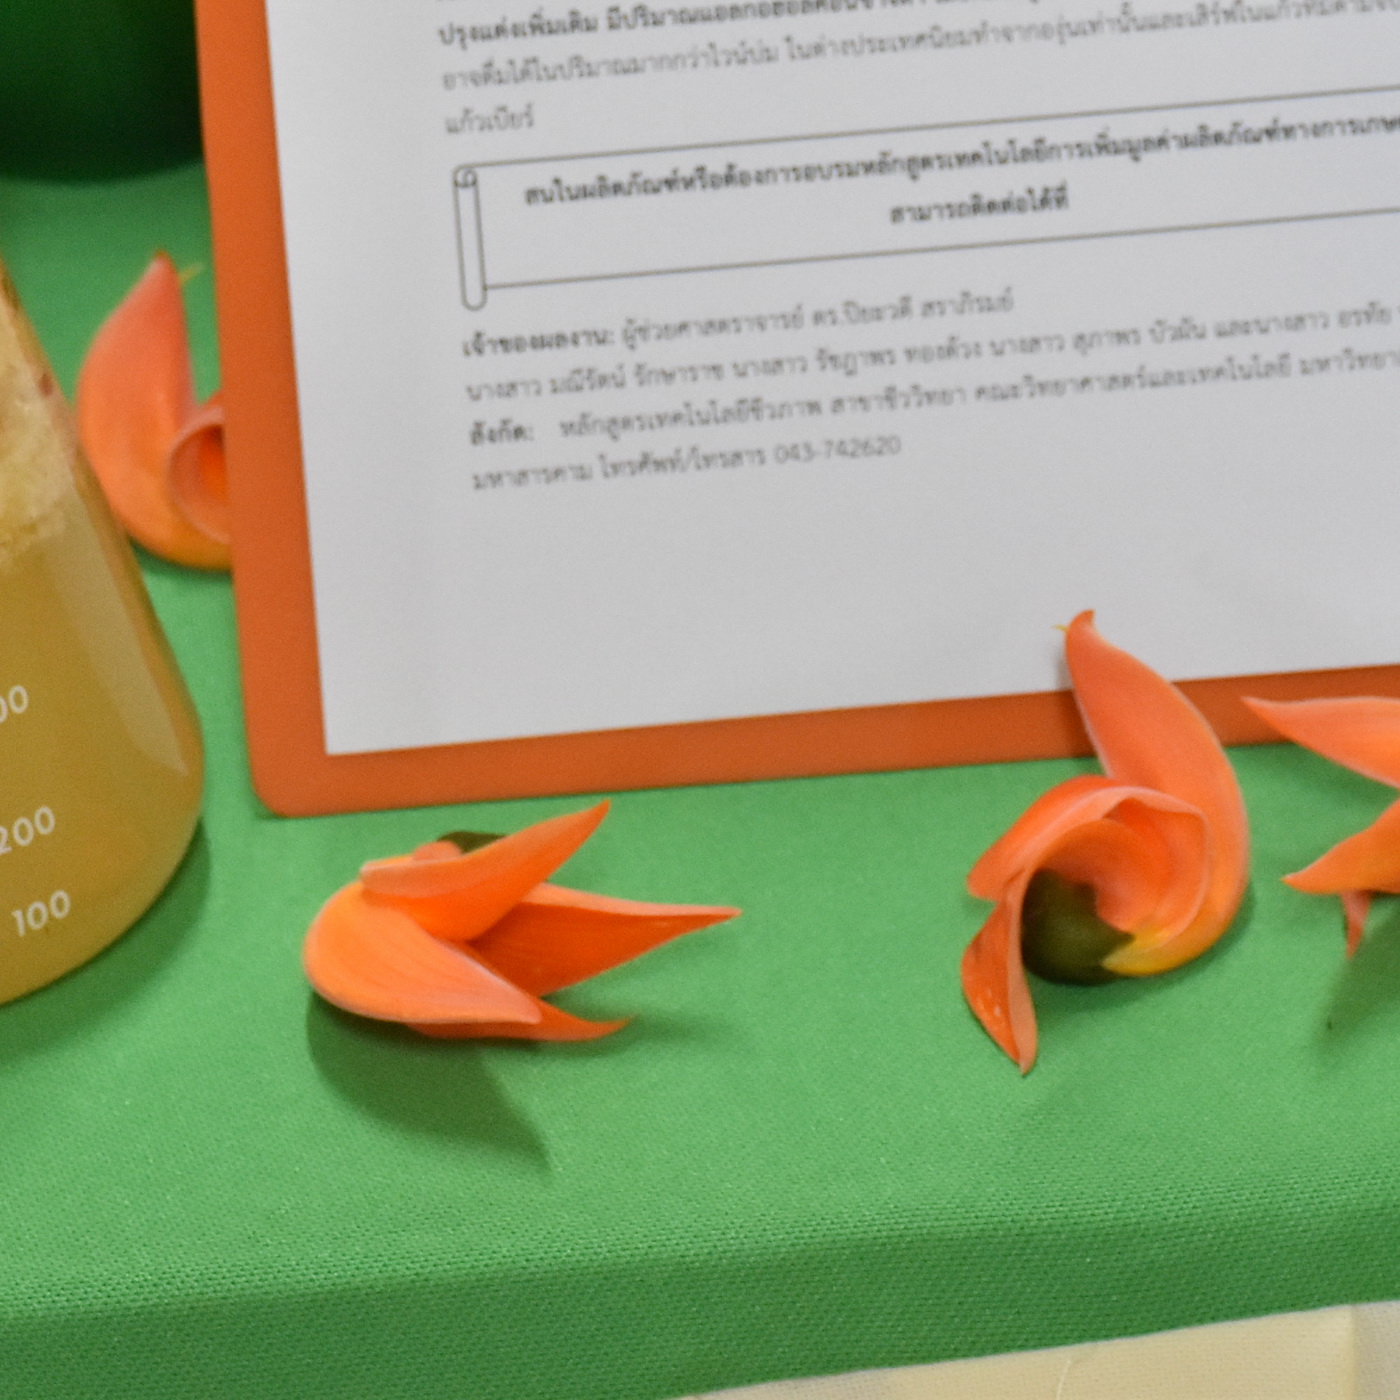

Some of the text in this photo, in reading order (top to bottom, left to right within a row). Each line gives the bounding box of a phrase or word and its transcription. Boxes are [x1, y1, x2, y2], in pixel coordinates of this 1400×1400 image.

[465, 379, 542, 402] นางสาว
[549, 364, 626, 395] มณีรัตน์
[633, 363, 724, 387] รักษาราช
[732, 356, 808, 378] นางสาว
[989, 335, 1065, 357] นางสาว
[1072, 328, 1141, 356] สุภาพร
[1148, 317, 1207, 344] บัวผัน
[1338, 301, 1391, 328] อรทัย
[469, 417, 533, 447] สังกัด:
[774, 435, 901, 464] 043-742620
[10, 889, 73, 939] 100
